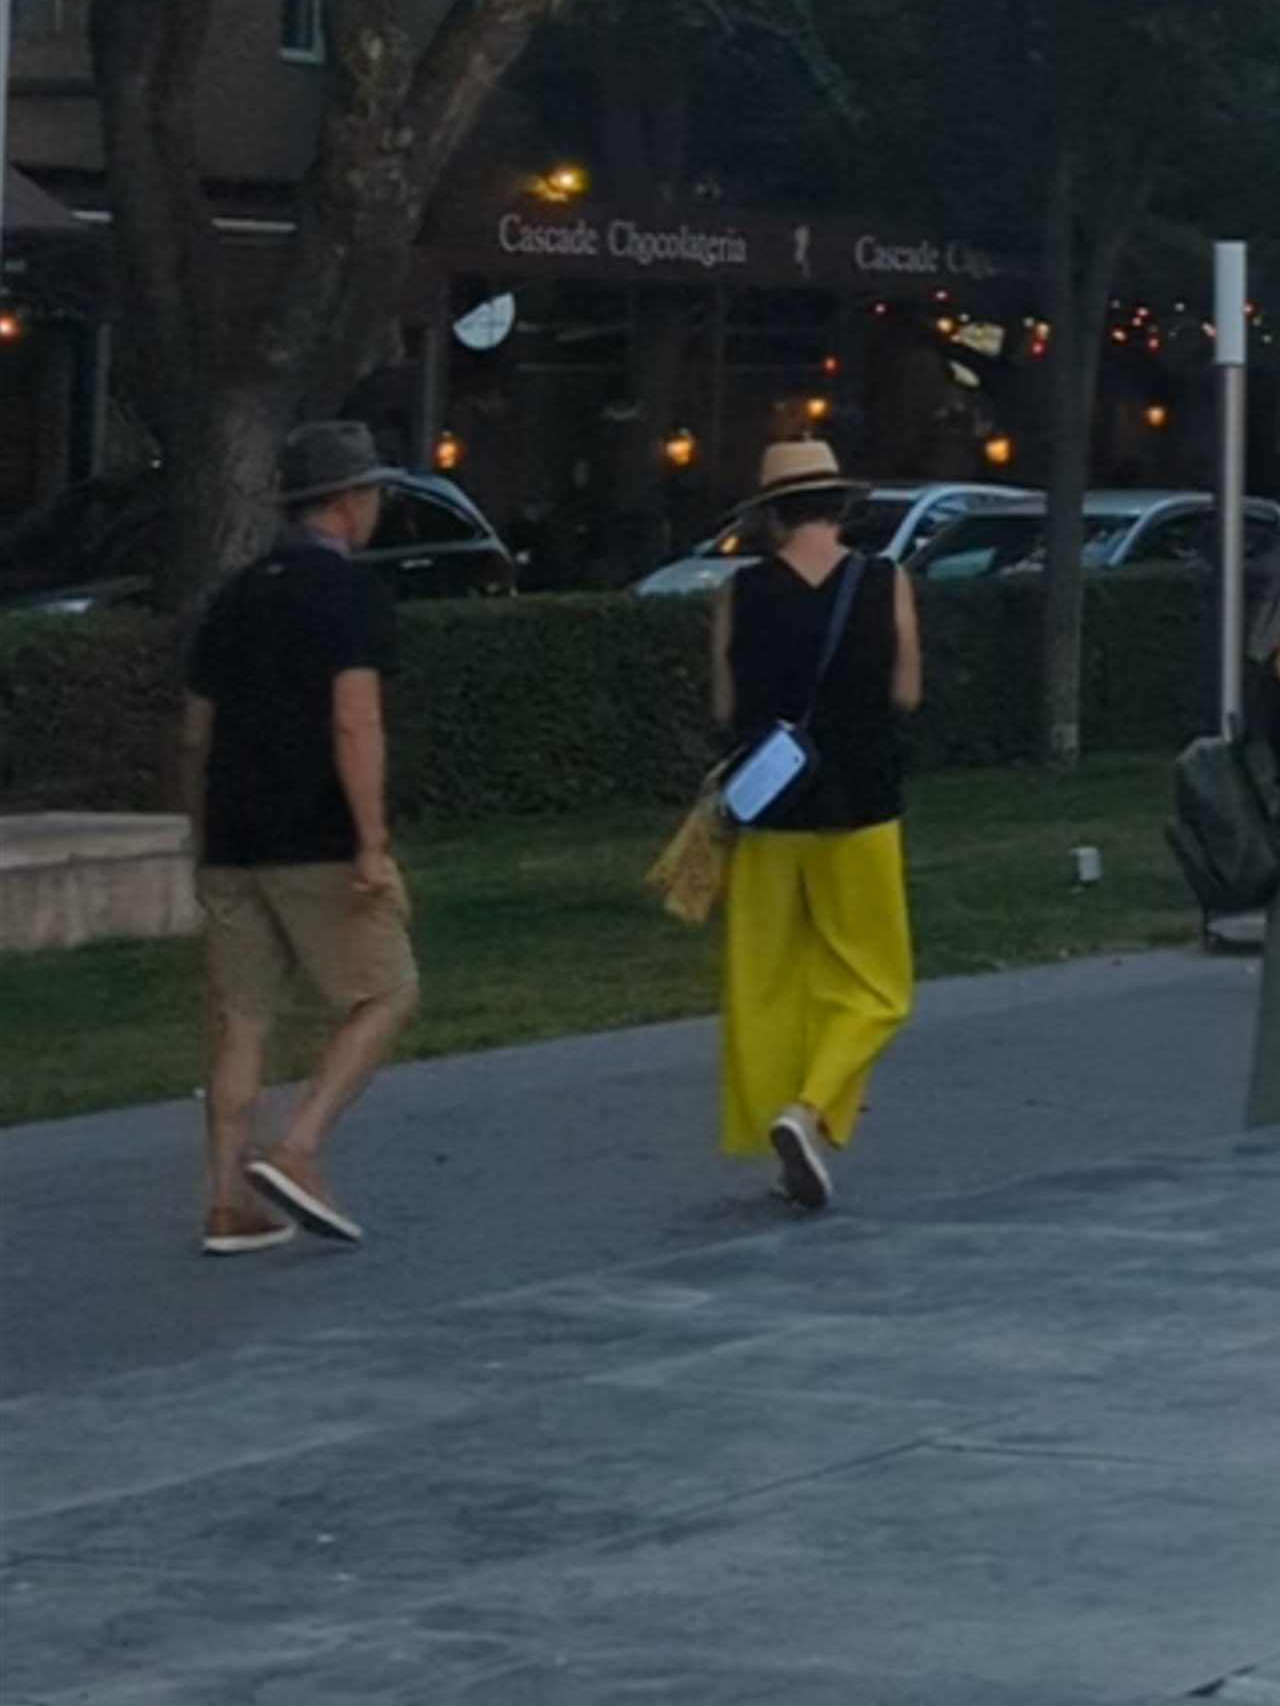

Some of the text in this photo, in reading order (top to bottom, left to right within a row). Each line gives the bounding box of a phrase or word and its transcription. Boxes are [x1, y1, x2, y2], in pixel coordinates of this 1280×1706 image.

[500, 214, 747, 267] Cascade Chocolateria
[854, 235, 939, 272] Cascade
